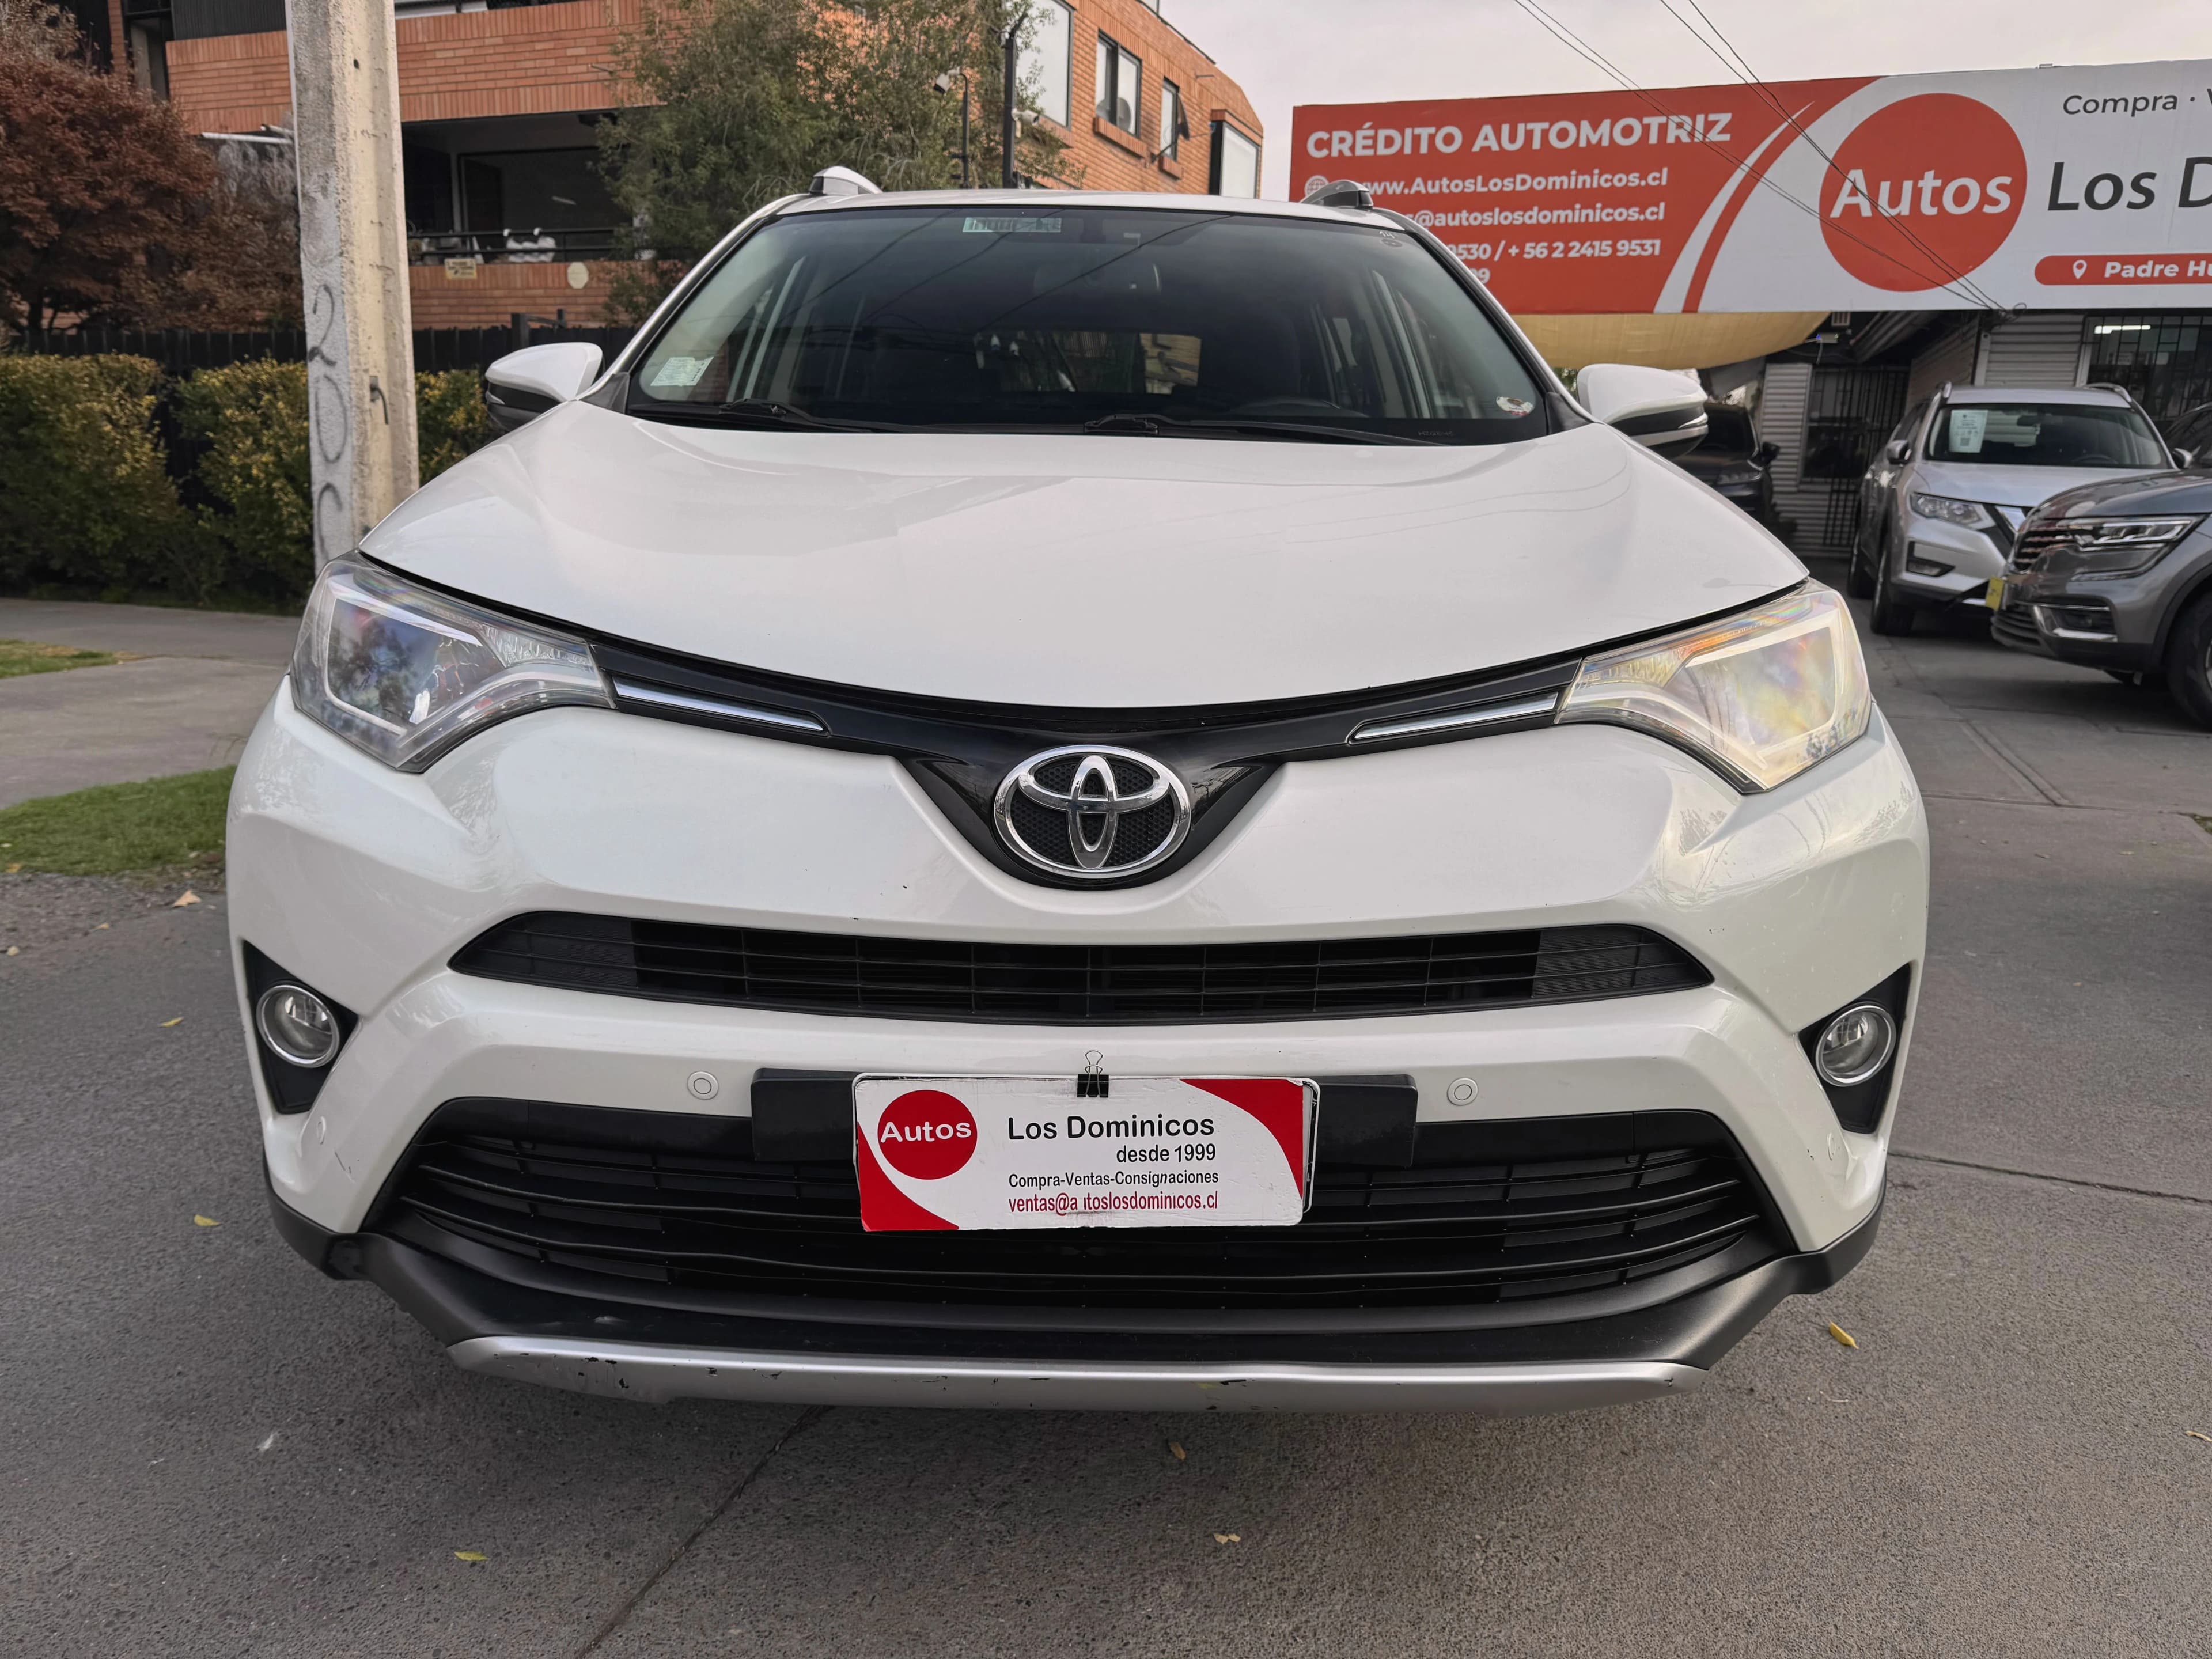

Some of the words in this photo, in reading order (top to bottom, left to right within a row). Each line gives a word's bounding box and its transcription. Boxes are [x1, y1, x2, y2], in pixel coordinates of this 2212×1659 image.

[2063, 94, 2177, 117] Compra
[1306, 122, 1463, 158] CRÉDITO
[1471, 113, 1732, 152] AUTOMOTRIZ
[1362, 167, 1668, 195] ww.AutosLosDominicos.cl
[1830, 168, 2012, 218] Autos
[2048, 161, 2157, 211] Los
[1508, 245, 1520, 257] +
[1523, 242, 1548, 259] 56
[1551, 241, 1565, 258] 2
[1567, 240, 1612, 257] 2415
[1616, 239, 1661, 256] 9531
[2104, 260, 2179, 278] Padre
[880, 1120, 972, 1144] Autos
[1008, 1117, 1058, 1140] Los
[1067, 1113, 1214, 1138] Dominicos
[1116, 1144, 1169, 1163] desde
[1174, 1143, 1216, 1162] 1999
[1009, 1169, 1219, 1190] Compra-Ventas-Consignaciones
